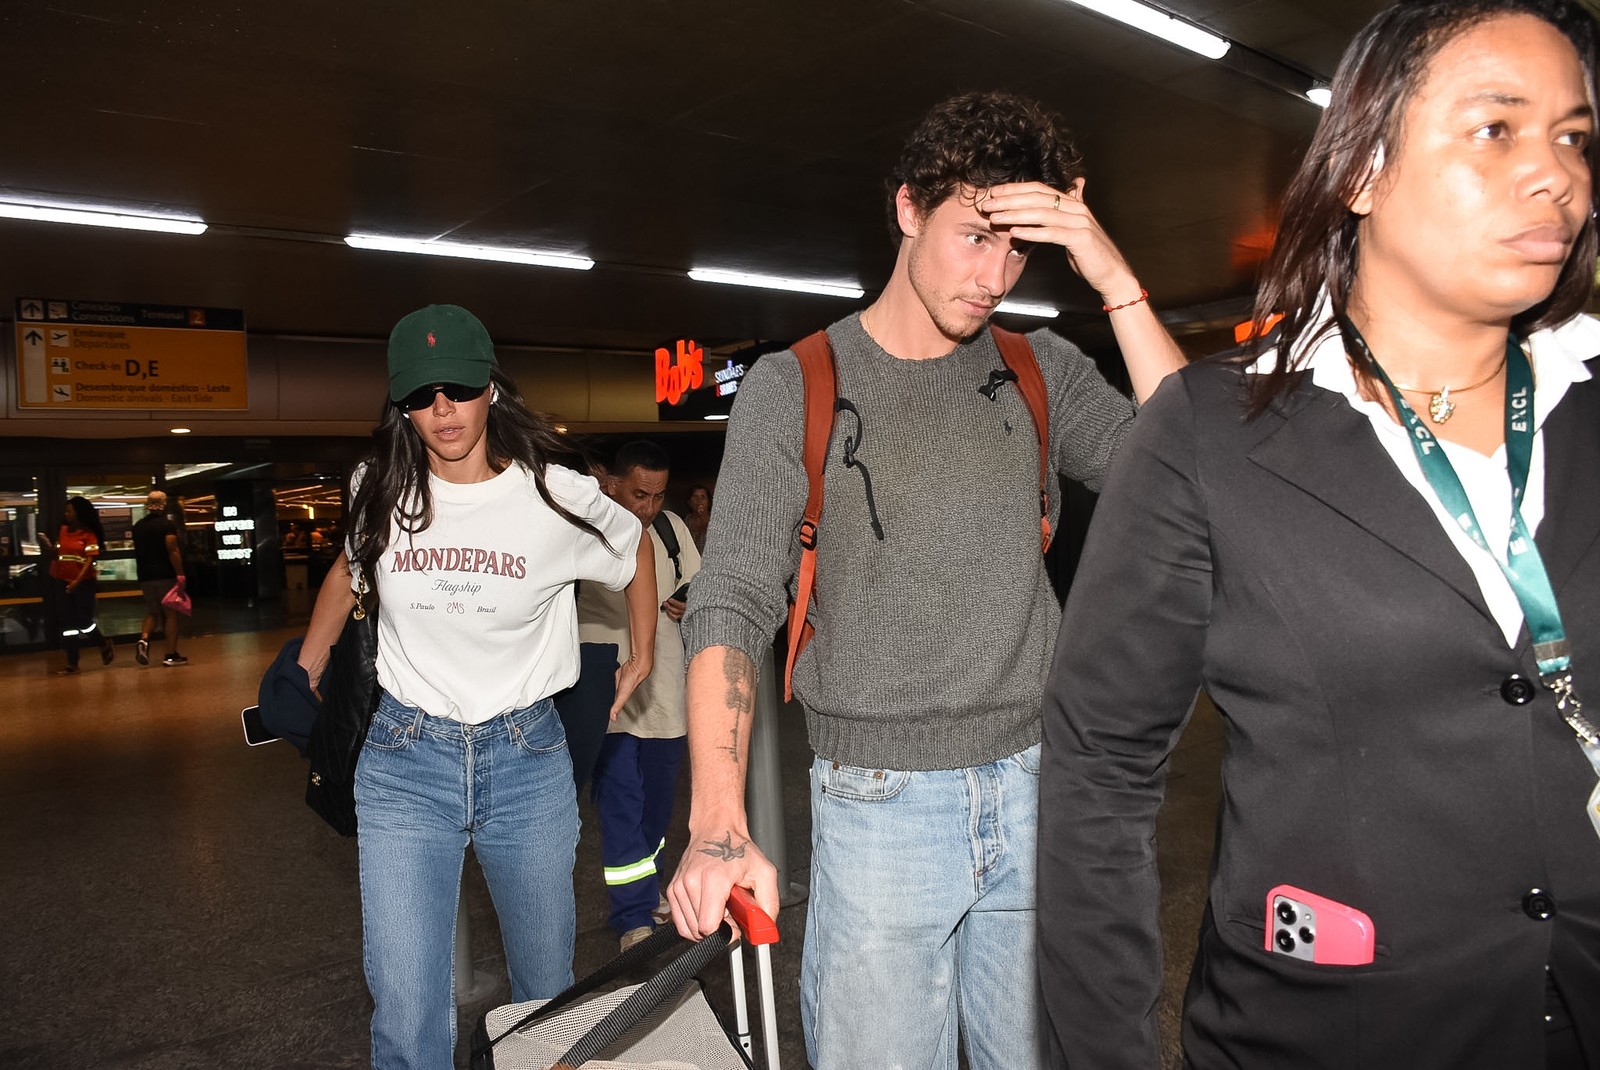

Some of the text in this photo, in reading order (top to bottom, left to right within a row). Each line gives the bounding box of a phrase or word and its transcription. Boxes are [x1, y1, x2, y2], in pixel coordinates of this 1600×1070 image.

[72, 312, 136, 323] Connections
[141, 309, 203, 324] Terminal 2
[73, 328, 126, 340] Embarque
[73, 339, 130, 350] Departures
[75, 359, 159, 380] Check-in D,E
[655, 340, 703, 405] Bob's
[75, 383, 146, 394] Desembarque
[147, 383, 199, 393] doméstico
[207, 384, 231, 393] Leste
[1511, 386, 1527, 432] EXCL
[391, 547, 527, 579] MONDEPARS
[431, 579, 482, 596] Flagship
